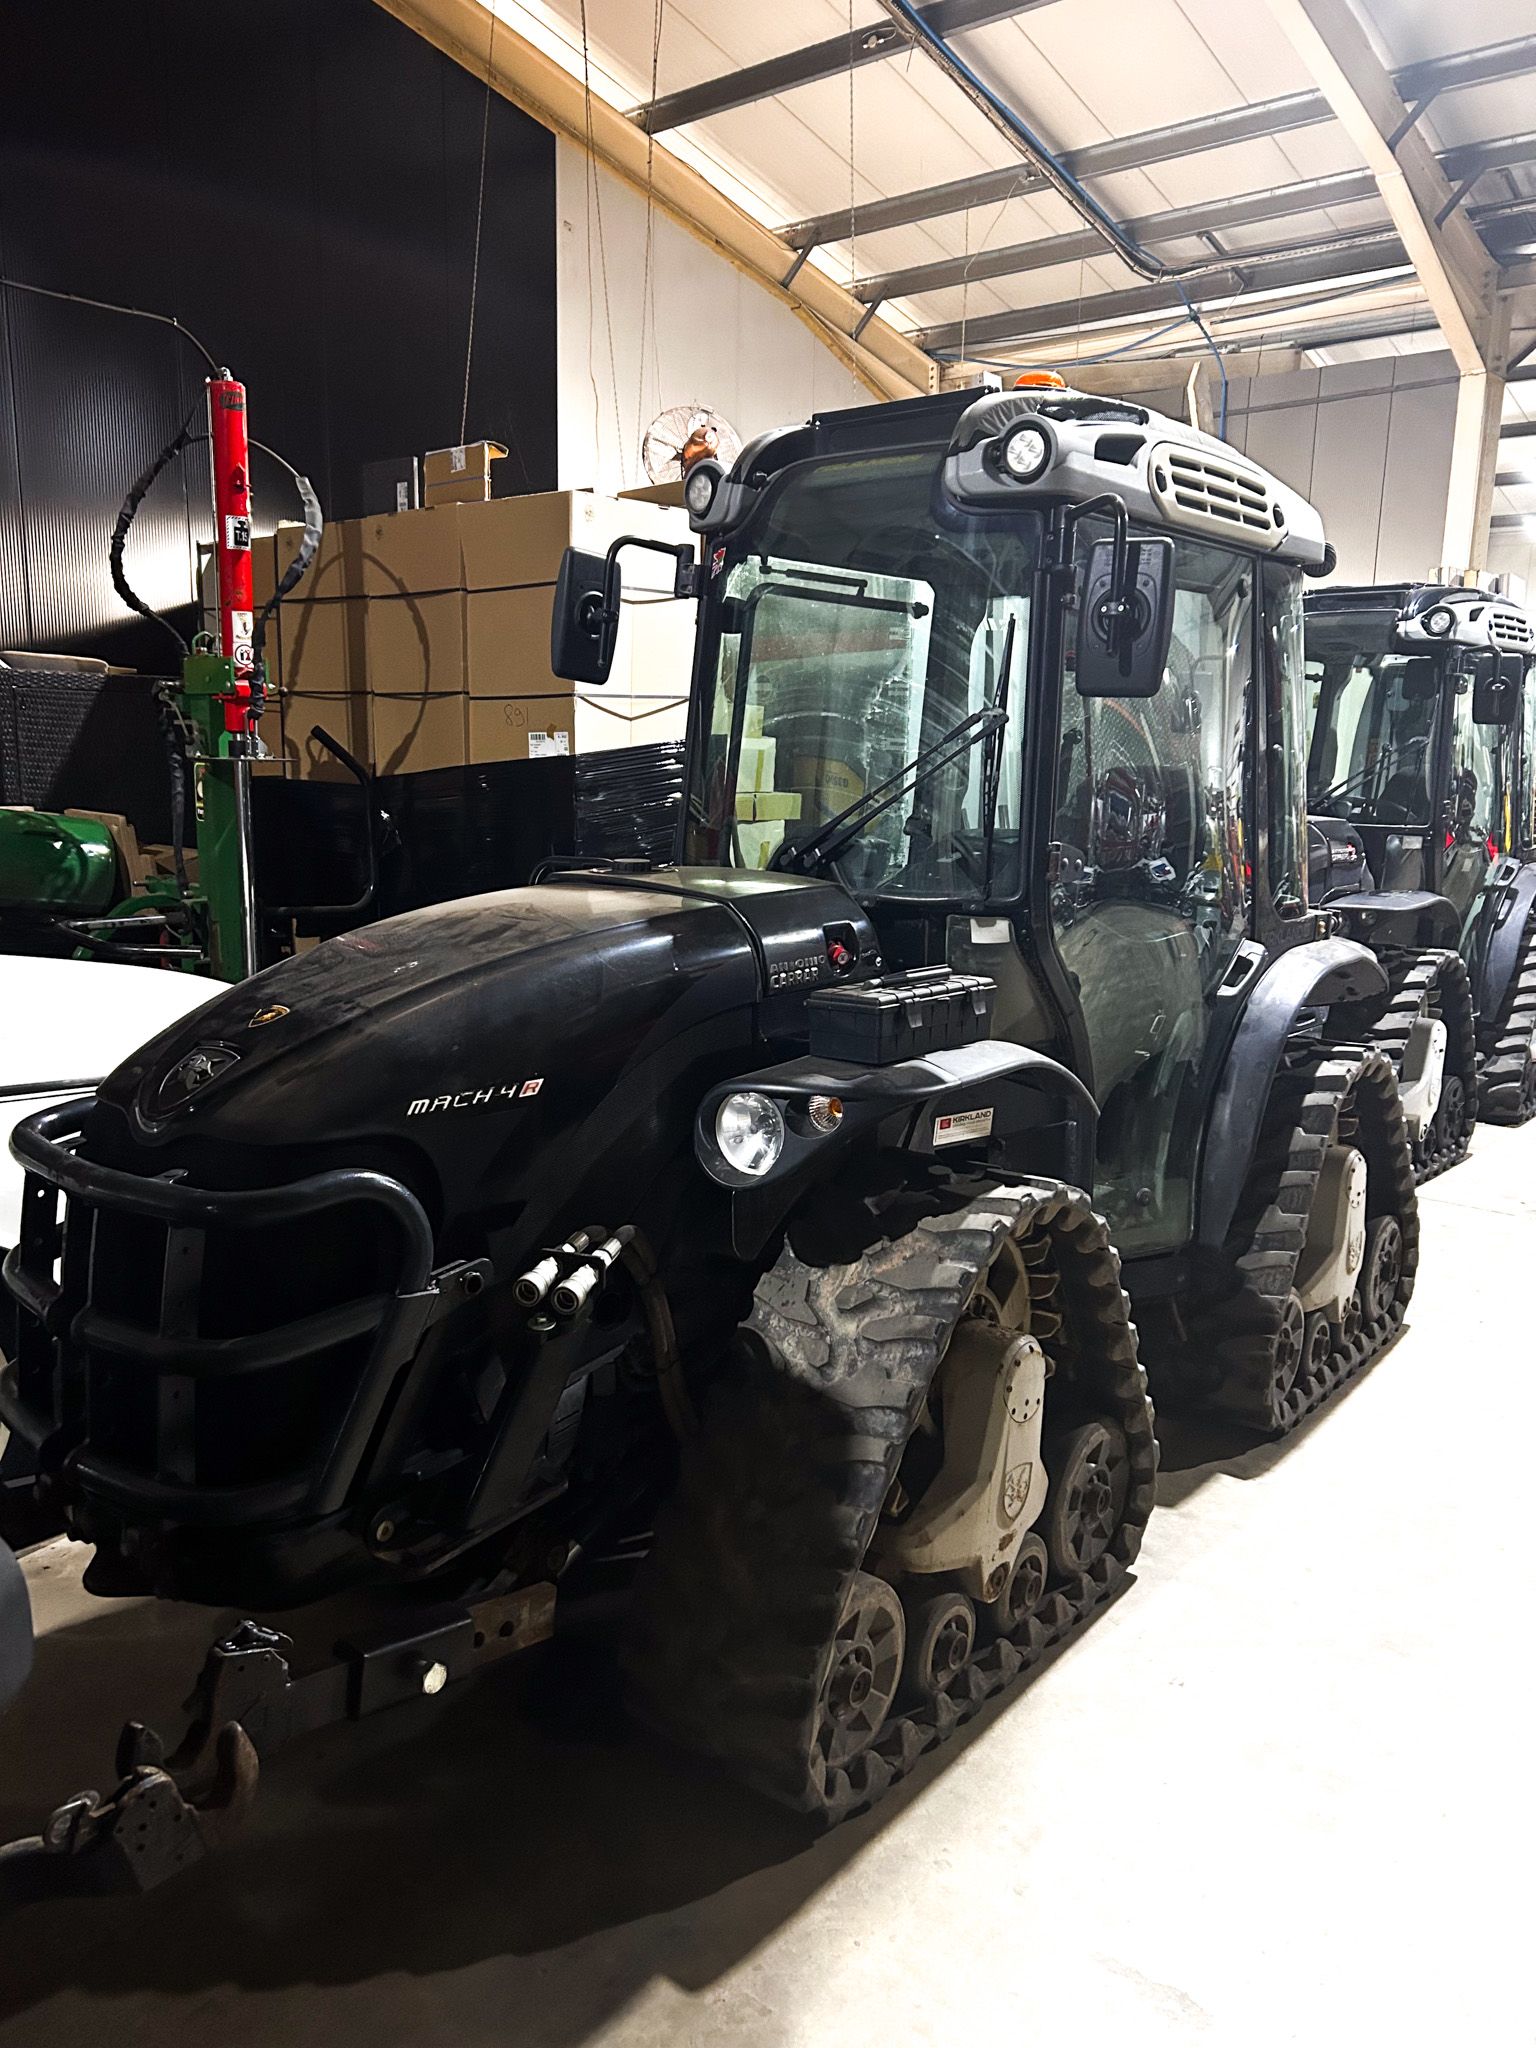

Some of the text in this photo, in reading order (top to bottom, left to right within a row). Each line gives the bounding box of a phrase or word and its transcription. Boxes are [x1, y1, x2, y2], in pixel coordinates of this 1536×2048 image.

[406, 1078, 545, 1117] MACH 4R
[952, 1110, 992, 1124] KIRKLAND
